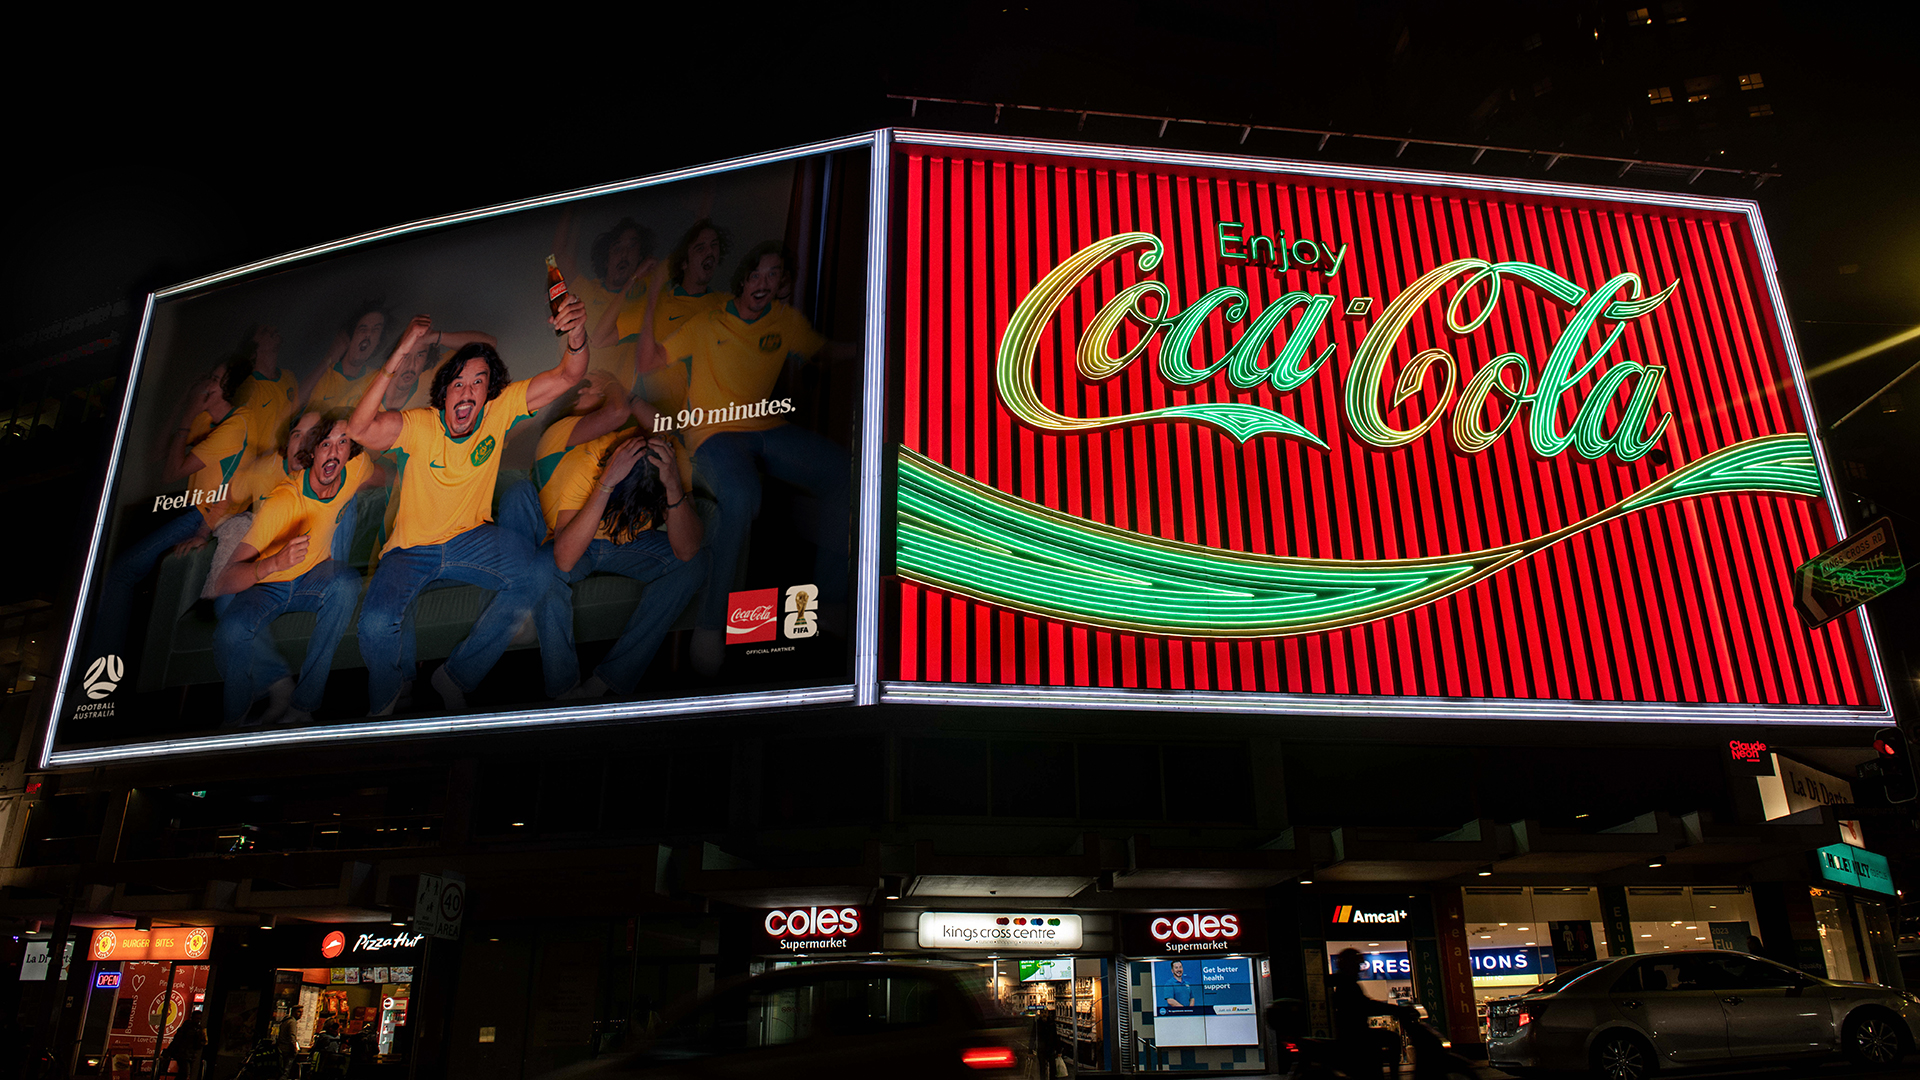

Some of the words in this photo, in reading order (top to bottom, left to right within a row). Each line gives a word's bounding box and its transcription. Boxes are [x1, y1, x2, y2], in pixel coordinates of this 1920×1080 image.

[1217, 220, 1349, 277] Enjoy
[652, 413, 673, 433] in
[676, 407, 704, 429] 90
[706, 397, 796, 425] minutes.
[152, 490, 190, 513] Feel
[189, 488, 205, 507] it
[205, 483, 229, 504] all
[1821, 556, 1845, 574] KINGS
[1845, 539, 1871, 560] CROSS
[1872, 532, 1884, 545] RD
[1830, 551, 1885, 592] Edgecliff
[1834, 572, 1891, 608] Vaucluse
[792, 626, 809, 634] FIFA
[76, 702, 115, 712] FOOTBALL
[72, 709, 115, 721] AUSTRALIA
[1729, 740, 1767, 752] Claude
[1731, 749, 1760, 760] Neon
[1789, 771, 1806, 797] La
[1805, 777, 1821, 802] Di
[444, 893, 460, 912] 40
[764, 906, 859, 936] coles
[1352, 909, 1408, 923] Amcal+
[437, 922, 459, 937] AREA
[943, 925, 979, 941] kings
[979, 928, 1011, 939] cross
[1013, 928, 1056, 939] centre
[1150, 913, 1239, 940] coles
[1613, 906, 1628, 956] Equa
[1711, 927, 1729, 935] 2023
[122, 938, 151, 948] BURGER
[155, 938, 175, 948] BITES
[352, 933, 392, 952] Pizza
[393, 932, 425, 948] Hut
[780, 937, 847, 952] Supermarket
[1165, 940, 1228, 953] Supermarket
[1714, 939, 1734, 950] Flu
[26, 954, 36, 963] La
[1470, 953, 1529, 970] IONS
[1202, 966, 1216, 974] Get
[98, 974, 120, 986] OPEN
[159, 979, 186, 989] Pinpple
[1204, 982, 1231, 991] support
[1423, 951, 1440, 1030] PHARMA
[125, 994, 138, 1035] BURGERS
